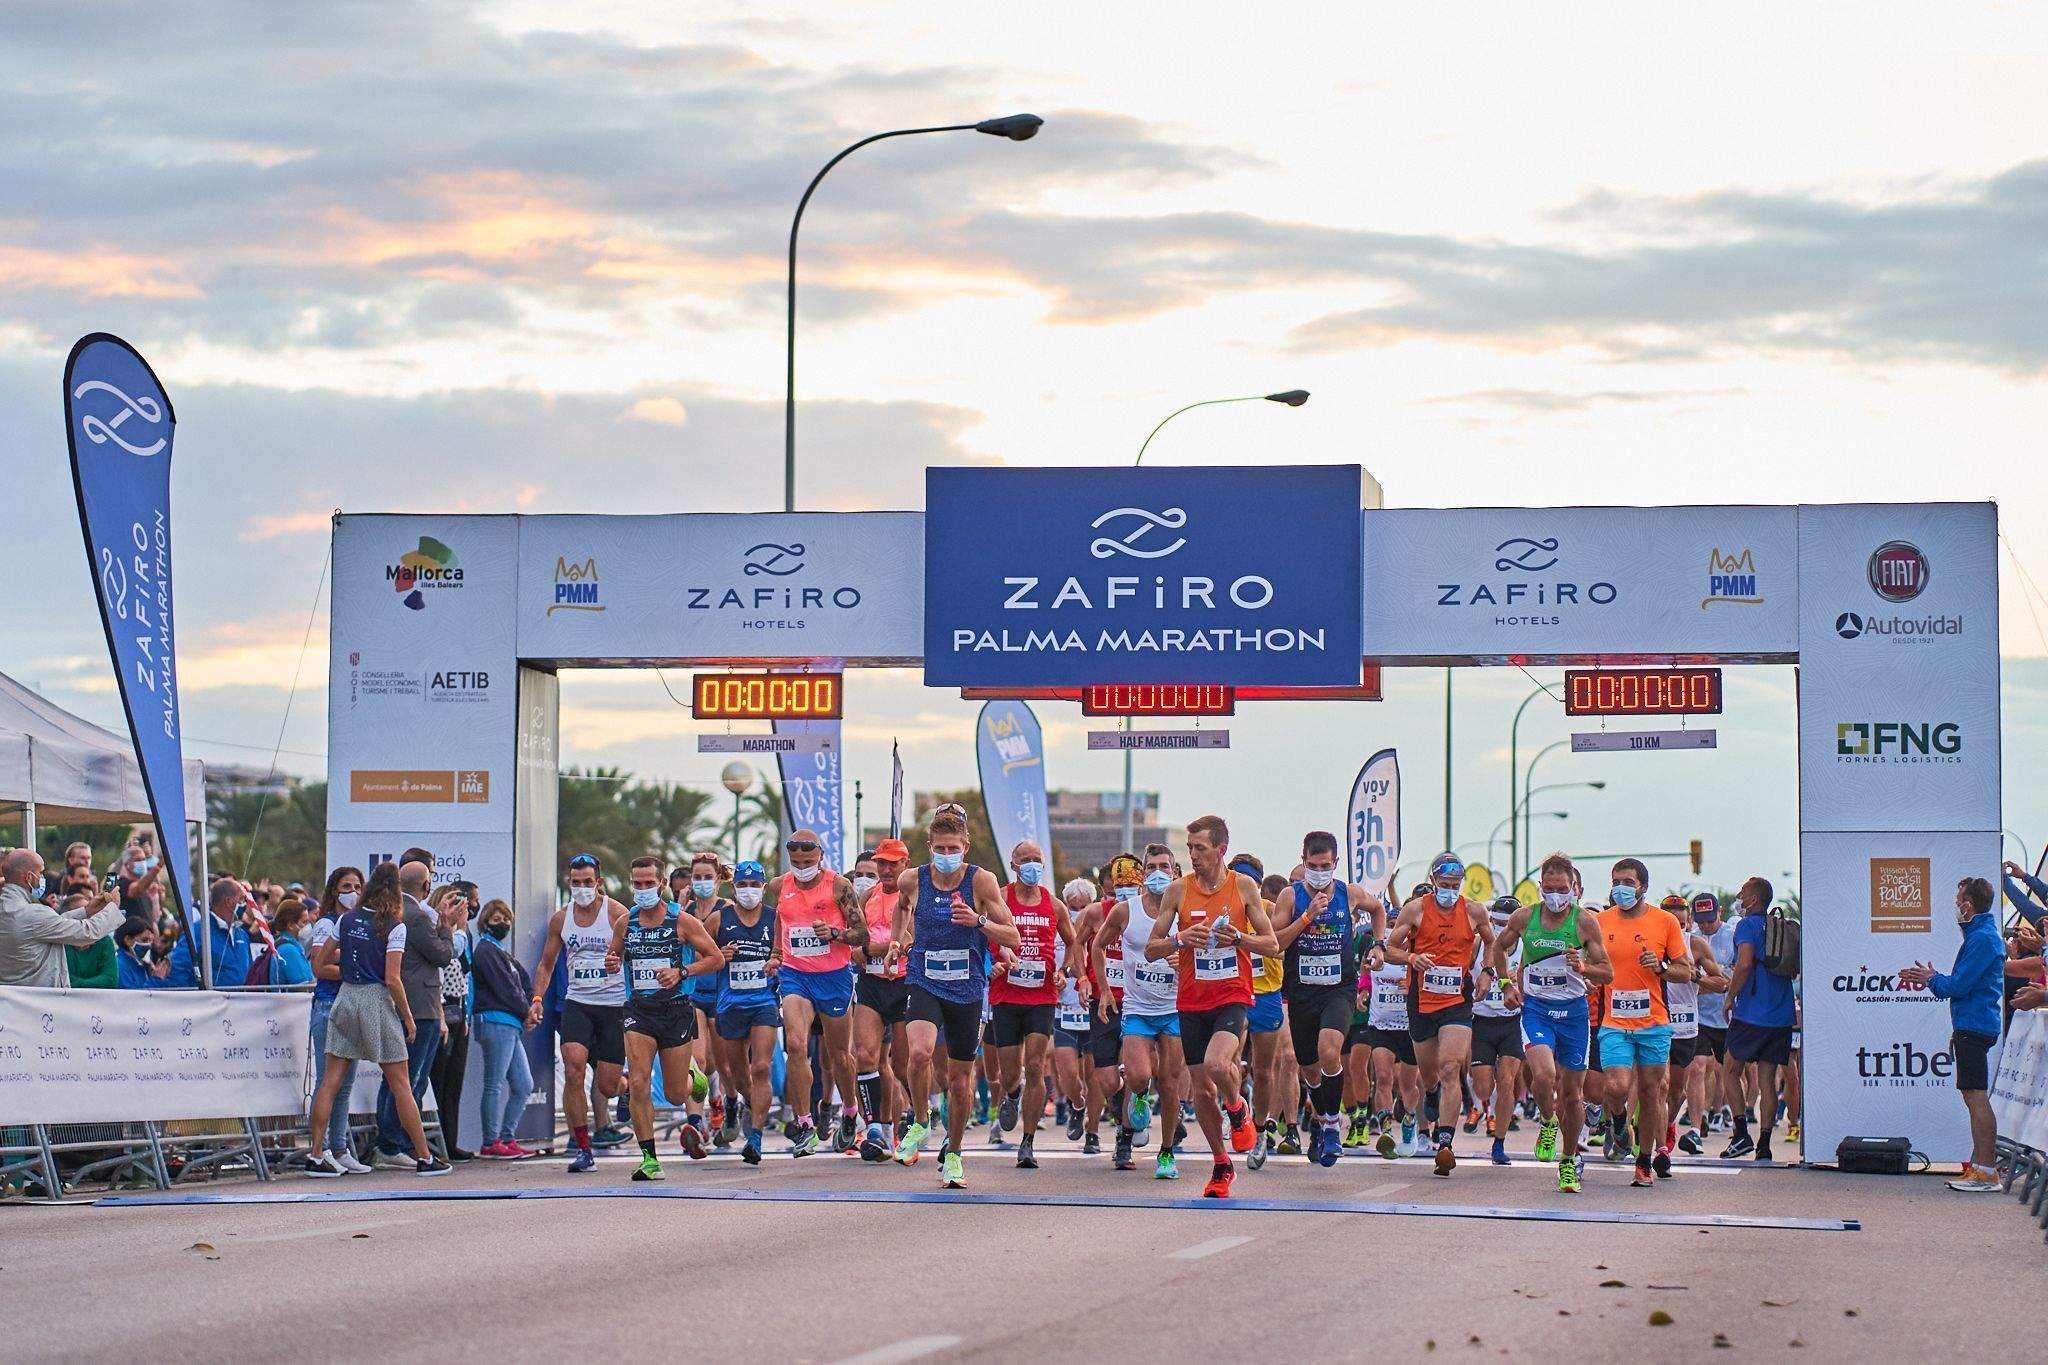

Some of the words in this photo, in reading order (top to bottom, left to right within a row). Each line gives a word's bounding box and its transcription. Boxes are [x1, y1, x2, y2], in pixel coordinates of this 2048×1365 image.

[386, 565, 464, 580] Mallorca
[1882, 560, 1916, 586] FIAT
[155, 510, 169, 649] MARATHON
[1710, 575, 1756, 596] PMM
[555, 584, 598, 604] PMM
[743, 620, 805, 629] HOTELS
[1495, 616, 1560, 625] HOTELS
[1864, 615, 1963, 635] Autovidal
[953, 629, 1087, 652] PALMA
[1095, 628, 1325, 652] MARATHON
[431, 671, 489, 689] AETIB
[162, 656, 175, 739] PALMA
[702, 680, 832, 712] 00:00:00
[1573, 675, 1709, 709] 00:00:00
[1120, 736, 1145, 748] HALF
[1145, 735, 1199, 748] MARATHON
[1629, 737, 1643, 749] 10
[1644, 736, 1660, 749] KM
[1874, 723, 1962, 754] FNG
[742, 739, 796, 751] MARATHON
[462, 783, 483, 793] IME
[1363, 780, 1390, 795] voy
[828, 751, 840, 837] MARATHO
[1371, 794, 1377, 803] a
[1355, 808, 1383, 846] 3h
[798, 937, 821, 947] 804
[1020, 946, 1039, 956] 2020
[943, 960, 950, 971] 1
[1208, 959, 1224, 970] 81
[579, 969, 600, 979] 710
[737, 971, 759, 981] 812
[1020, 969, 1035, 979] 62
[1142, 971, 1166, 983] 705
[1308, 966, 1332, 976] 801
[1432, 976, 1455, 986] 818
[1540, 976, 1555, 986] 15
[1384, 994, 1404, 1003] 808
[1856, 995, 1890, 1003] OCASIÓN
[1619, 1000, 1642, 1010] 821
[1856, 1042, 1953, 1078] tribe
